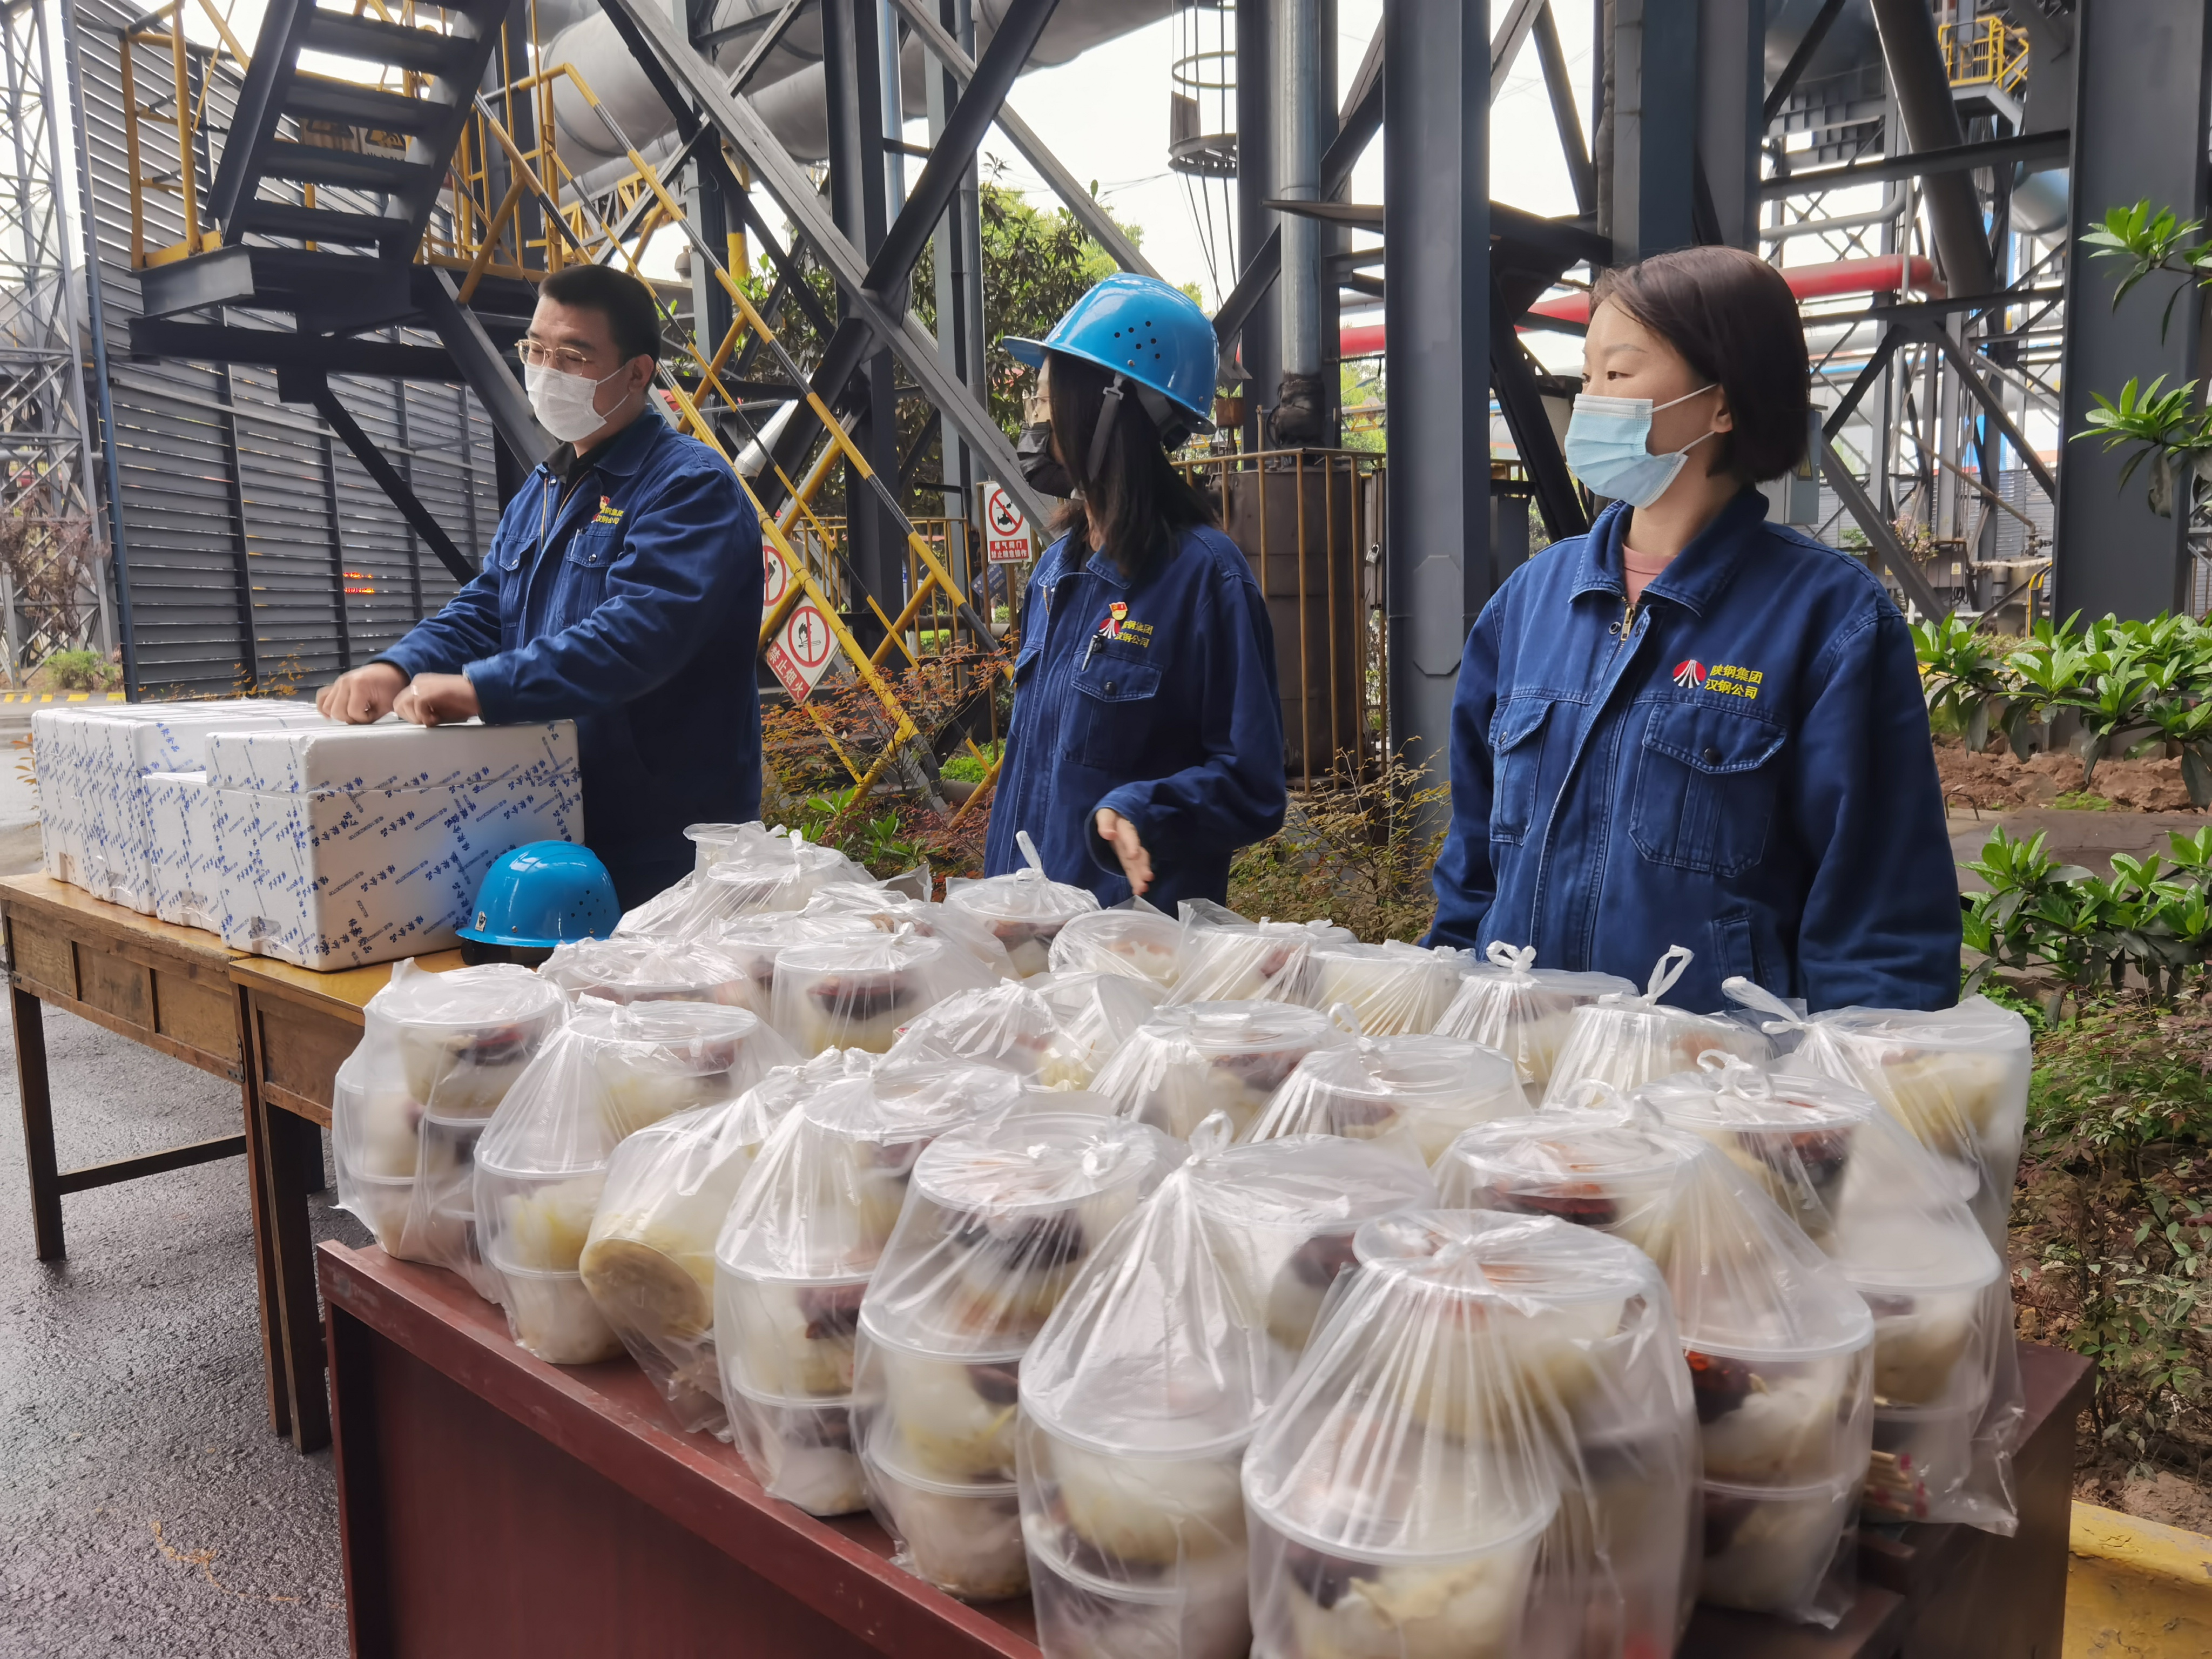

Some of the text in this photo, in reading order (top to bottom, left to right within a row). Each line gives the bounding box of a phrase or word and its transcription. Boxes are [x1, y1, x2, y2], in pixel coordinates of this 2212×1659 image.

[768, 646, 805, 699] 禁止烟火
[1710, 664, 1763, 684] 陕钢集团
[1704, 678, 1758, 699] 汉钢公司
